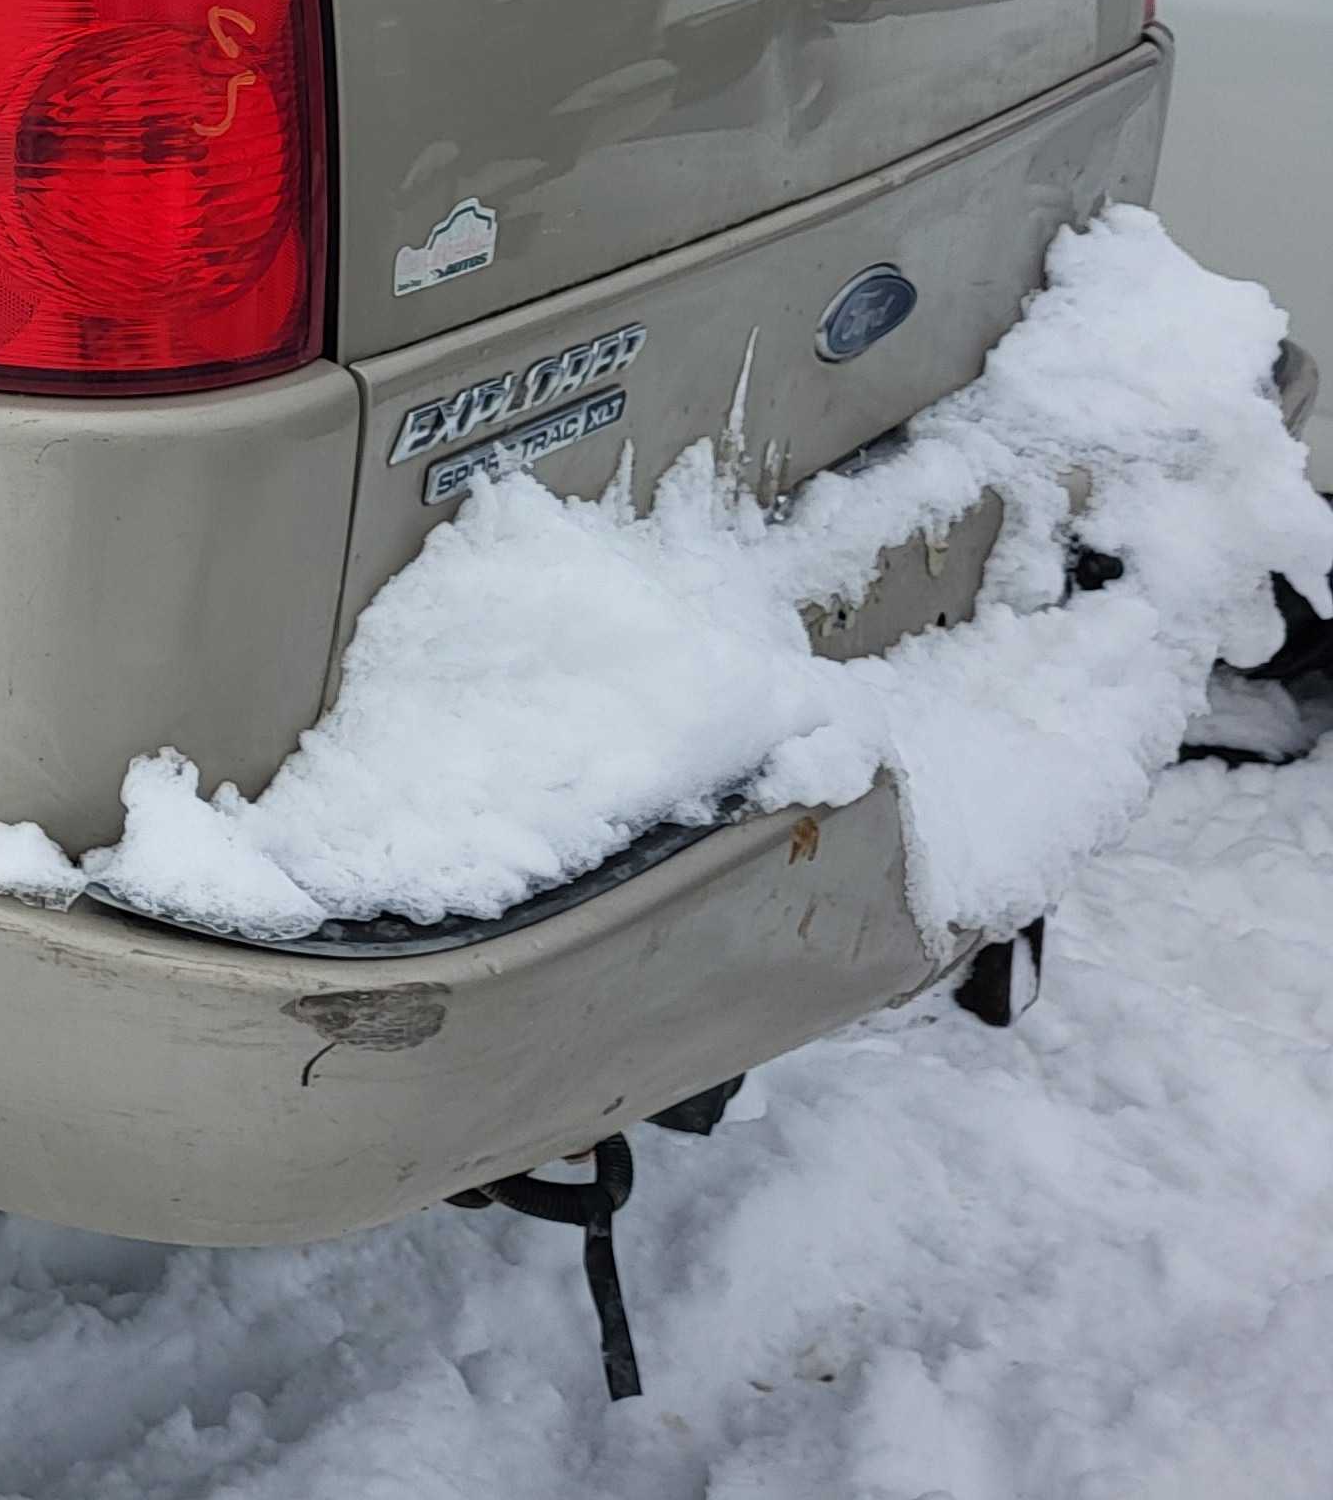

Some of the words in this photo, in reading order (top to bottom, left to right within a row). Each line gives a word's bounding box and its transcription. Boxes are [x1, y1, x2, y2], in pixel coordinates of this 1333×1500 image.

[388, 322, 647, 466] EXPLORER
[521, 416, 580, 461] TRAC
[587, 399, 623, 429] XLT
